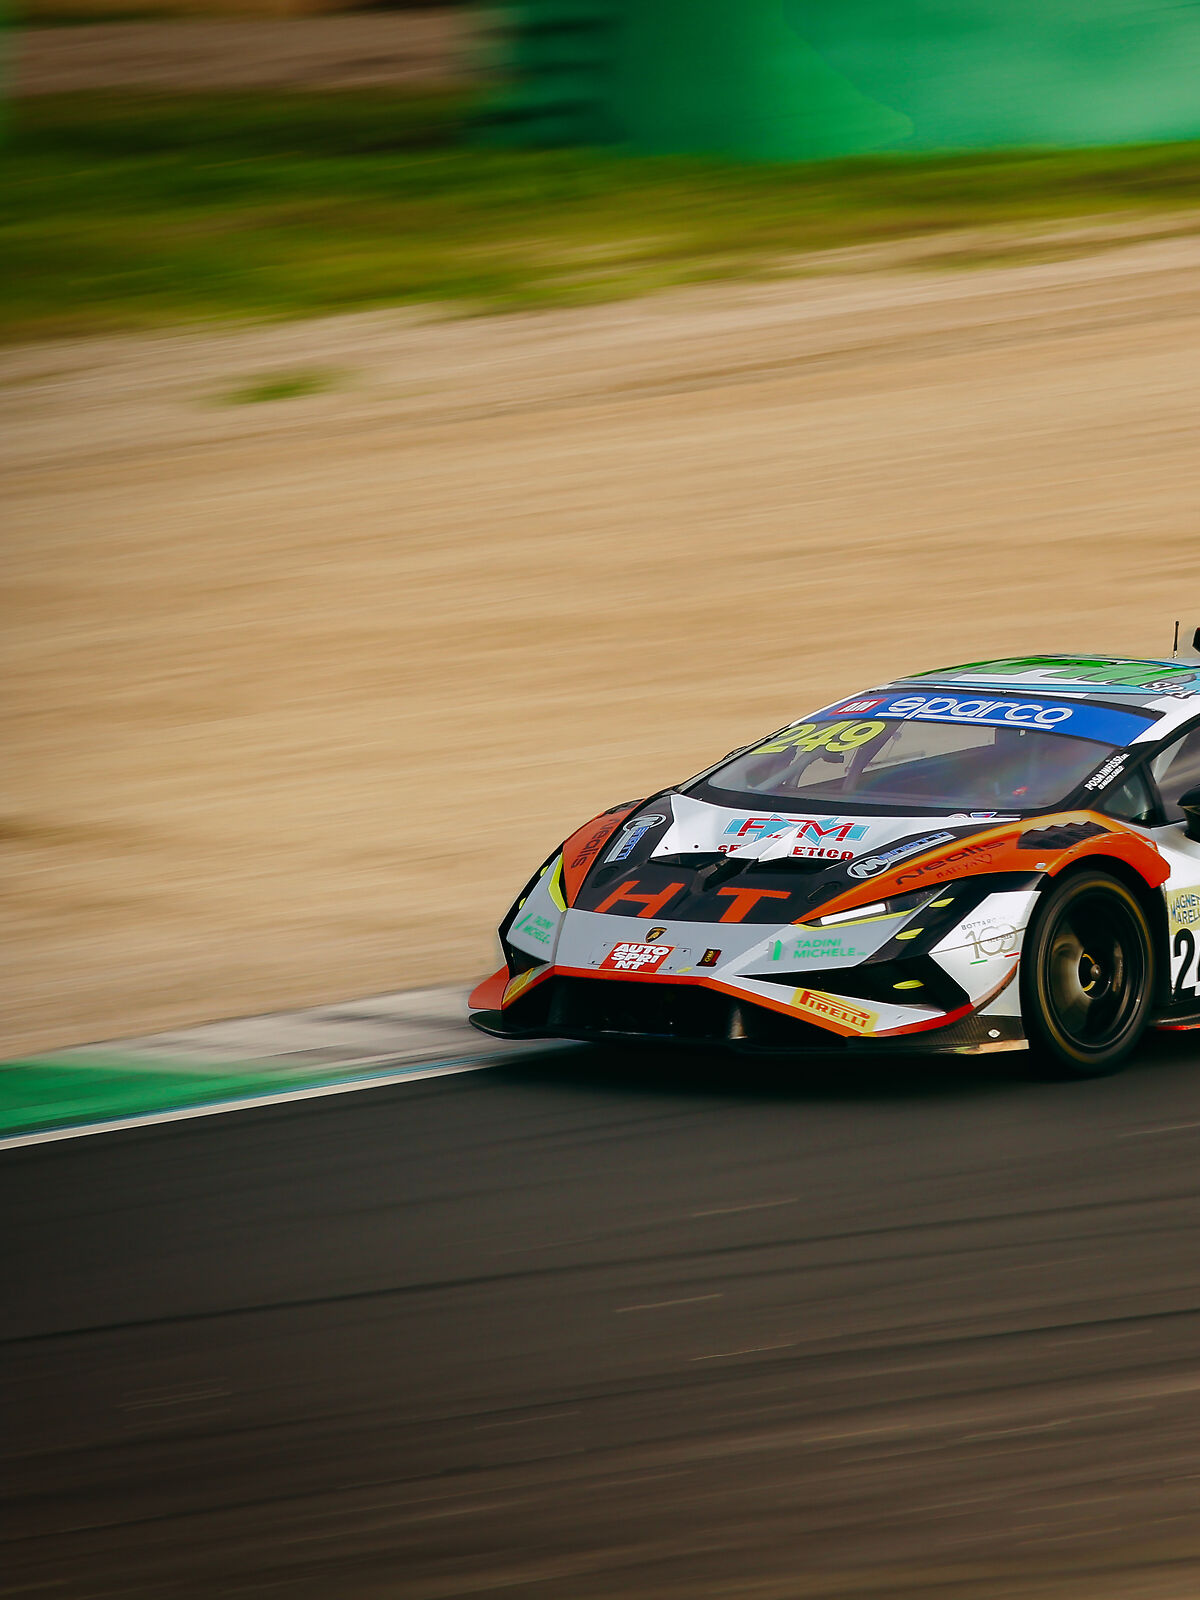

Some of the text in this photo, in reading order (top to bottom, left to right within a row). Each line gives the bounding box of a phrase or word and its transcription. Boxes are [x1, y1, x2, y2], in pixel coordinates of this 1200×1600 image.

[888, 694, 1074, 725] sparco
[750, 721, 887, 755] 249
[593, 881, 791, 922] H T
[796, 939, 842, 948] TADINI
[613, 944, 669, 956] AUTO
[793, 948, 856, 959] MICHELE
[611, 952, 660, 963] SPRI
[615, 961, 645, 970] NT
[800, 990, 870, 1028] PIRELLI
